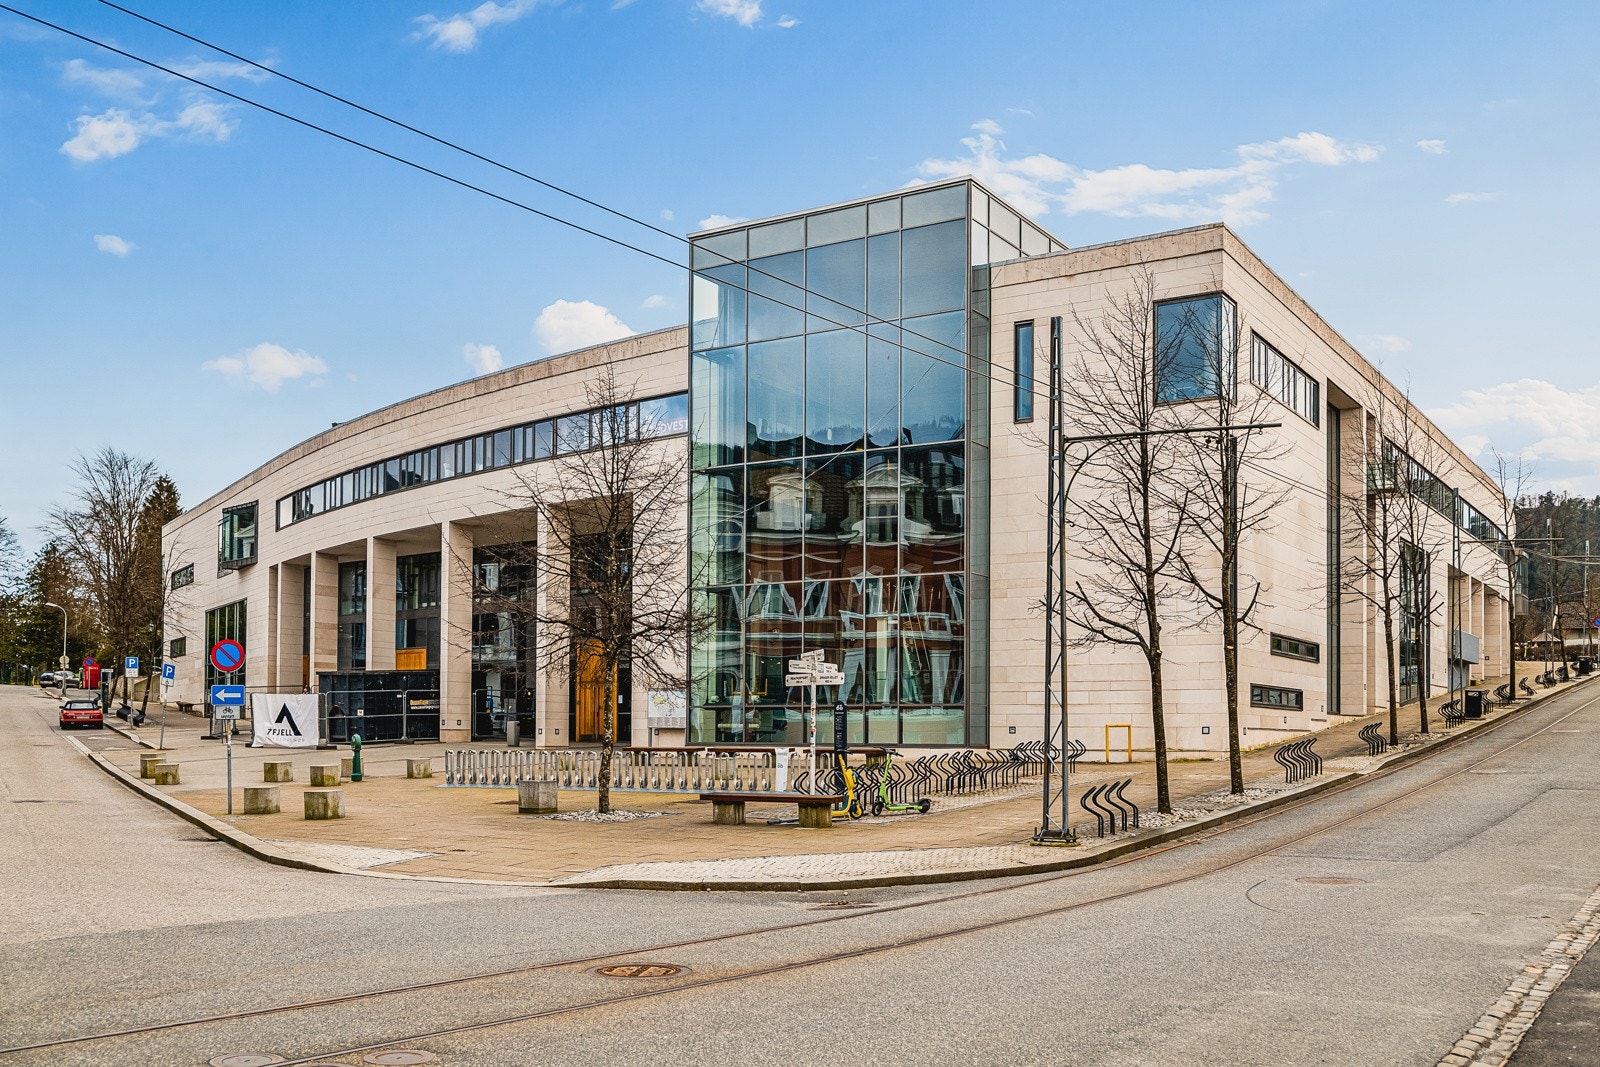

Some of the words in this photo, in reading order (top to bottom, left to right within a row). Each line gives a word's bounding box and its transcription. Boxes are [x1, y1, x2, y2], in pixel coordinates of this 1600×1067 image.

[129, 658, 136, 667] P
[165, 665, 173, 677] P
[266, 728, 293, 736] 7FJELL
